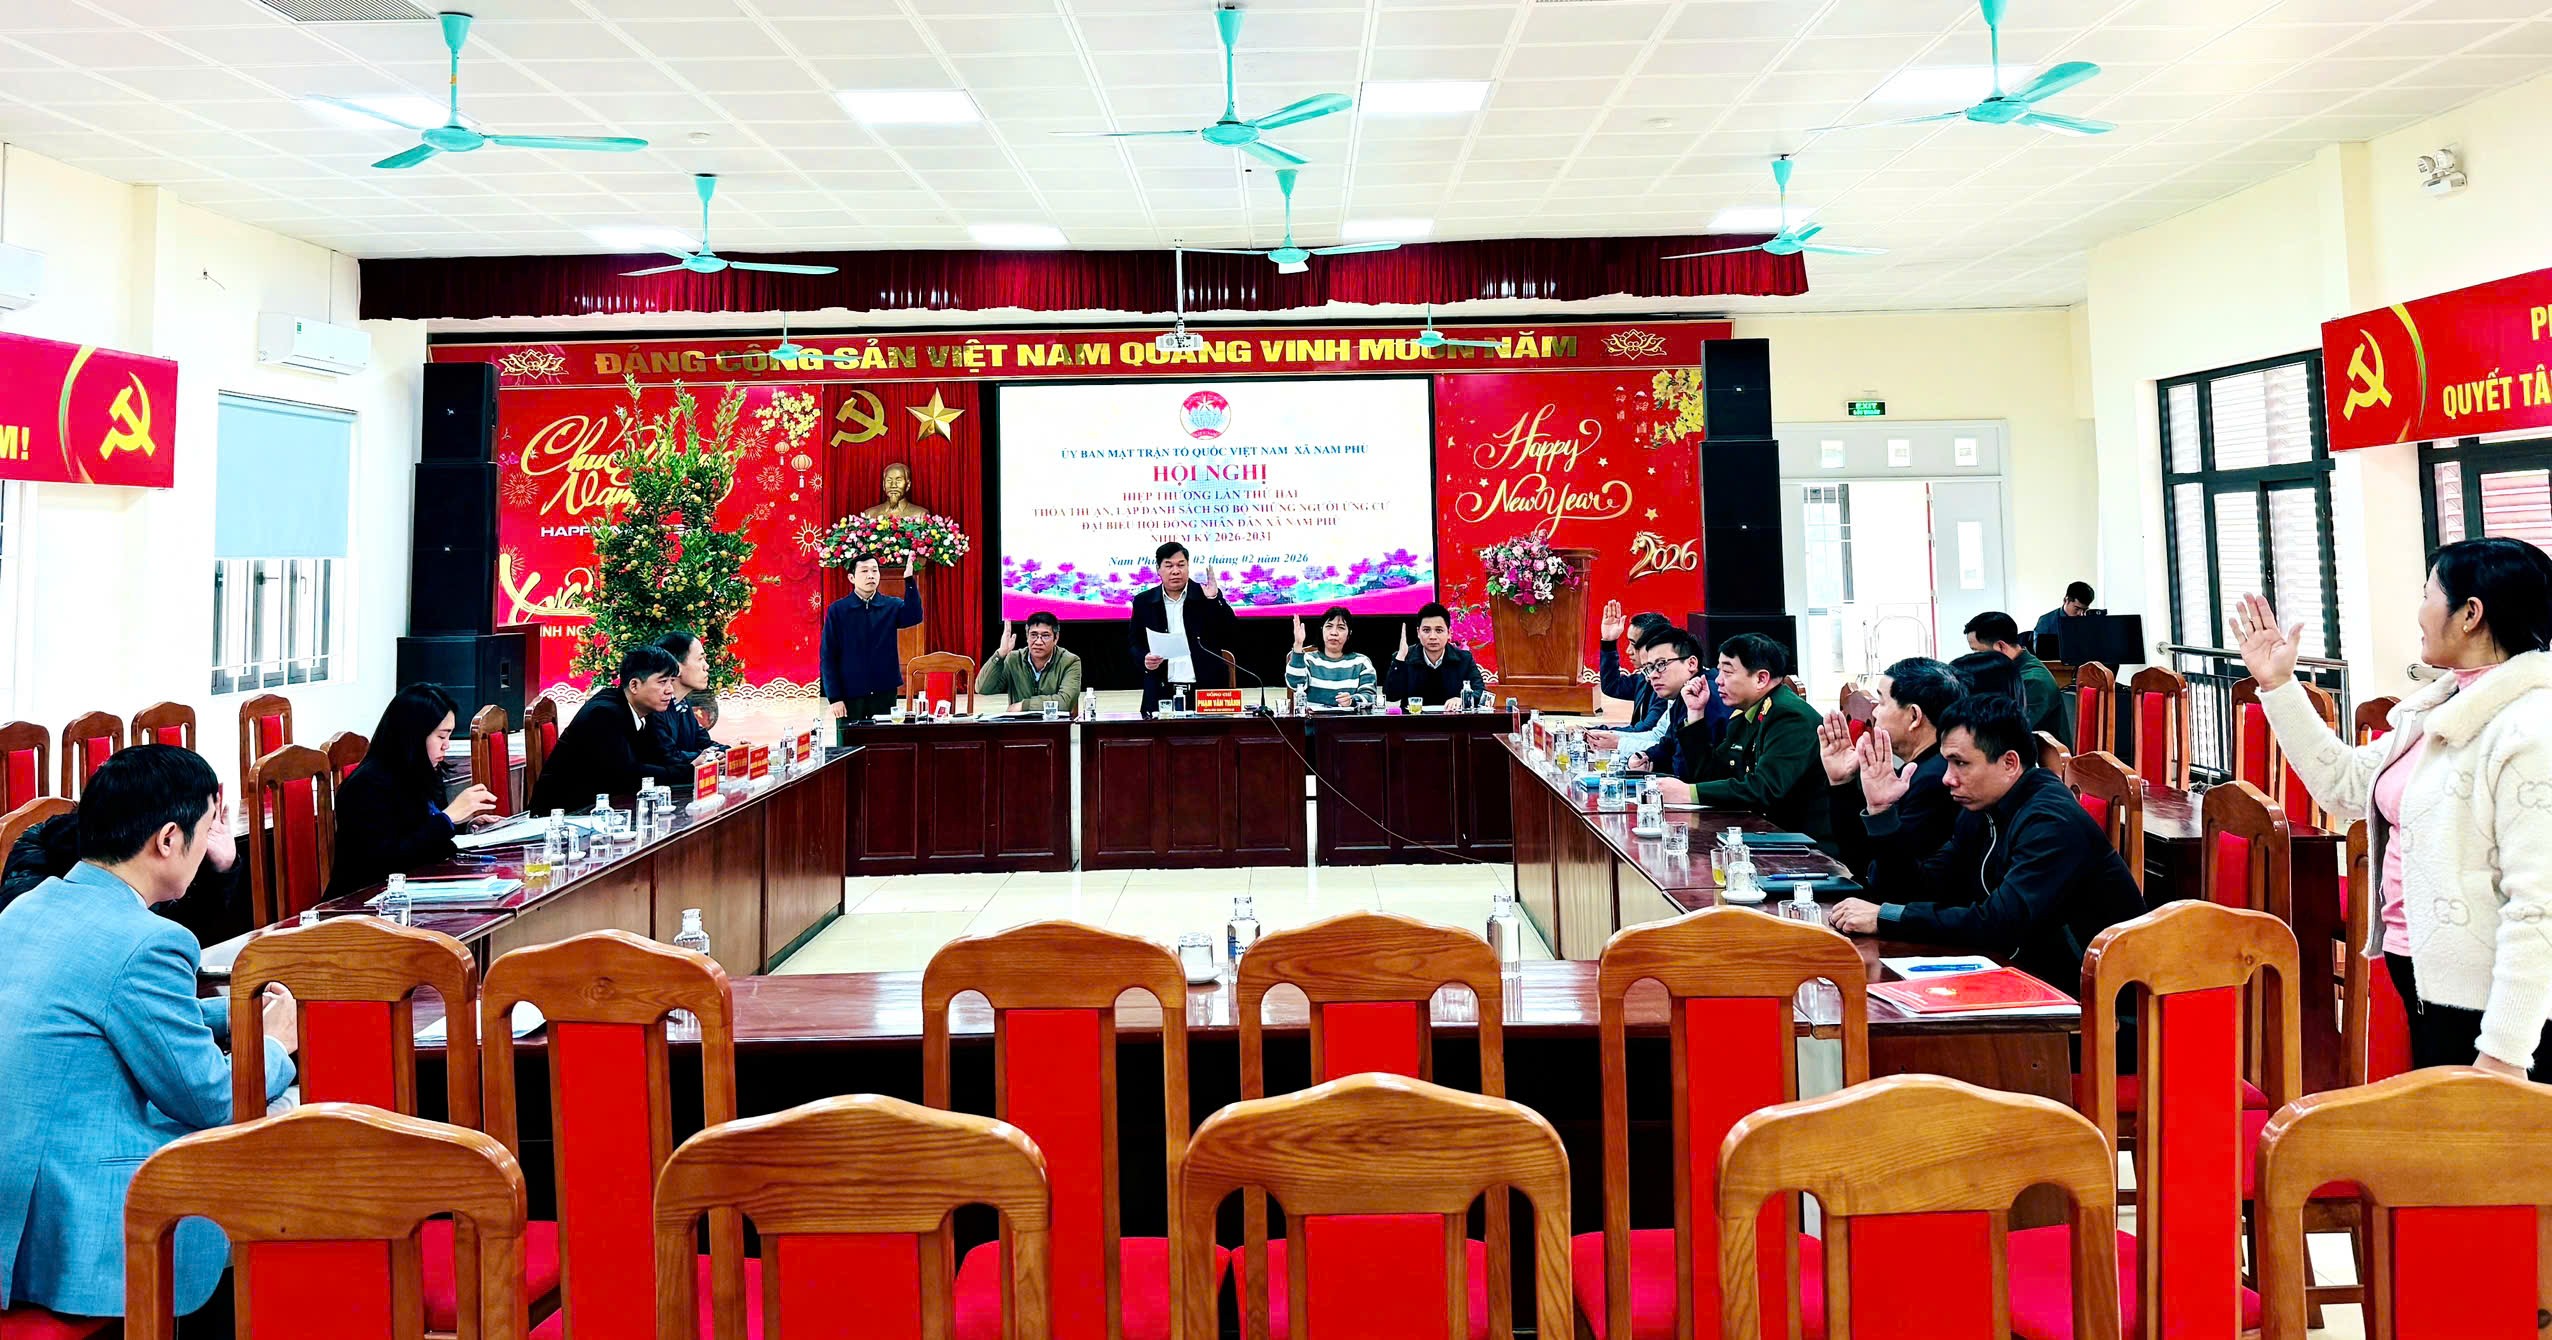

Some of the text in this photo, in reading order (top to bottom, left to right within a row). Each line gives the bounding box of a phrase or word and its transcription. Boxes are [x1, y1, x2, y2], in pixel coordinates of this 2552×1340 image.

[2531, 304, 2552, 340] P
[594, 344, 706, 374] ĐẢNG
[716, 344, 824, 377] CỘNG
[833, 338, 916, 370] SẢN
[926, 338, 1008, 372] VIỆT
[1016, 343, 1111, 366] NAM
[1120, 340, 1252, 366] QUANG
[1260, 339, 1351, 362] VINH
[1484, 330, 1577, 359] NĂM
[2443, 364, 2552, 419] QUYẾT TÂ
[1473, 404, 1602, 472] Happy
[1081, 449, 1105, 459] BAN
[1108, 448, 1135, 460] MẶT
[1137, 447, 1170, 460] TRẬN
[1192, 445, 1227, 458] QUỐC
[1229, 446, 1257, 458] VIỆT
[1261, 446, 1288, 456] NAM
[1294, 444, 1311, 455] XÃ
[1314, 445, 1341, 455] NAM
[1153, 463, 1267, 486] HỘI NGHỊ
[1276, 489, 1299, 499] HAI
[1142, 506, 1175, 516] DANH
[1178, 503, 1210, 514] SÁCH
[1455, 473, 1633, 539] New Year
[1200, 516, 1234, 528] NHÂN
[1286, 517, 1313, 527] NAM
[1214, 531, 1272, 542] 2026-2031
[1108, 556, 1133, 567] Nam
[1208, 554, 1239, 567] tháng
[1242, 555, 1254, 564] 02
[1284, 553, 1309, 564] 2026
[1628, 531, 1699, 582] 2026
[499, 553, 594, 623] Xuâ
